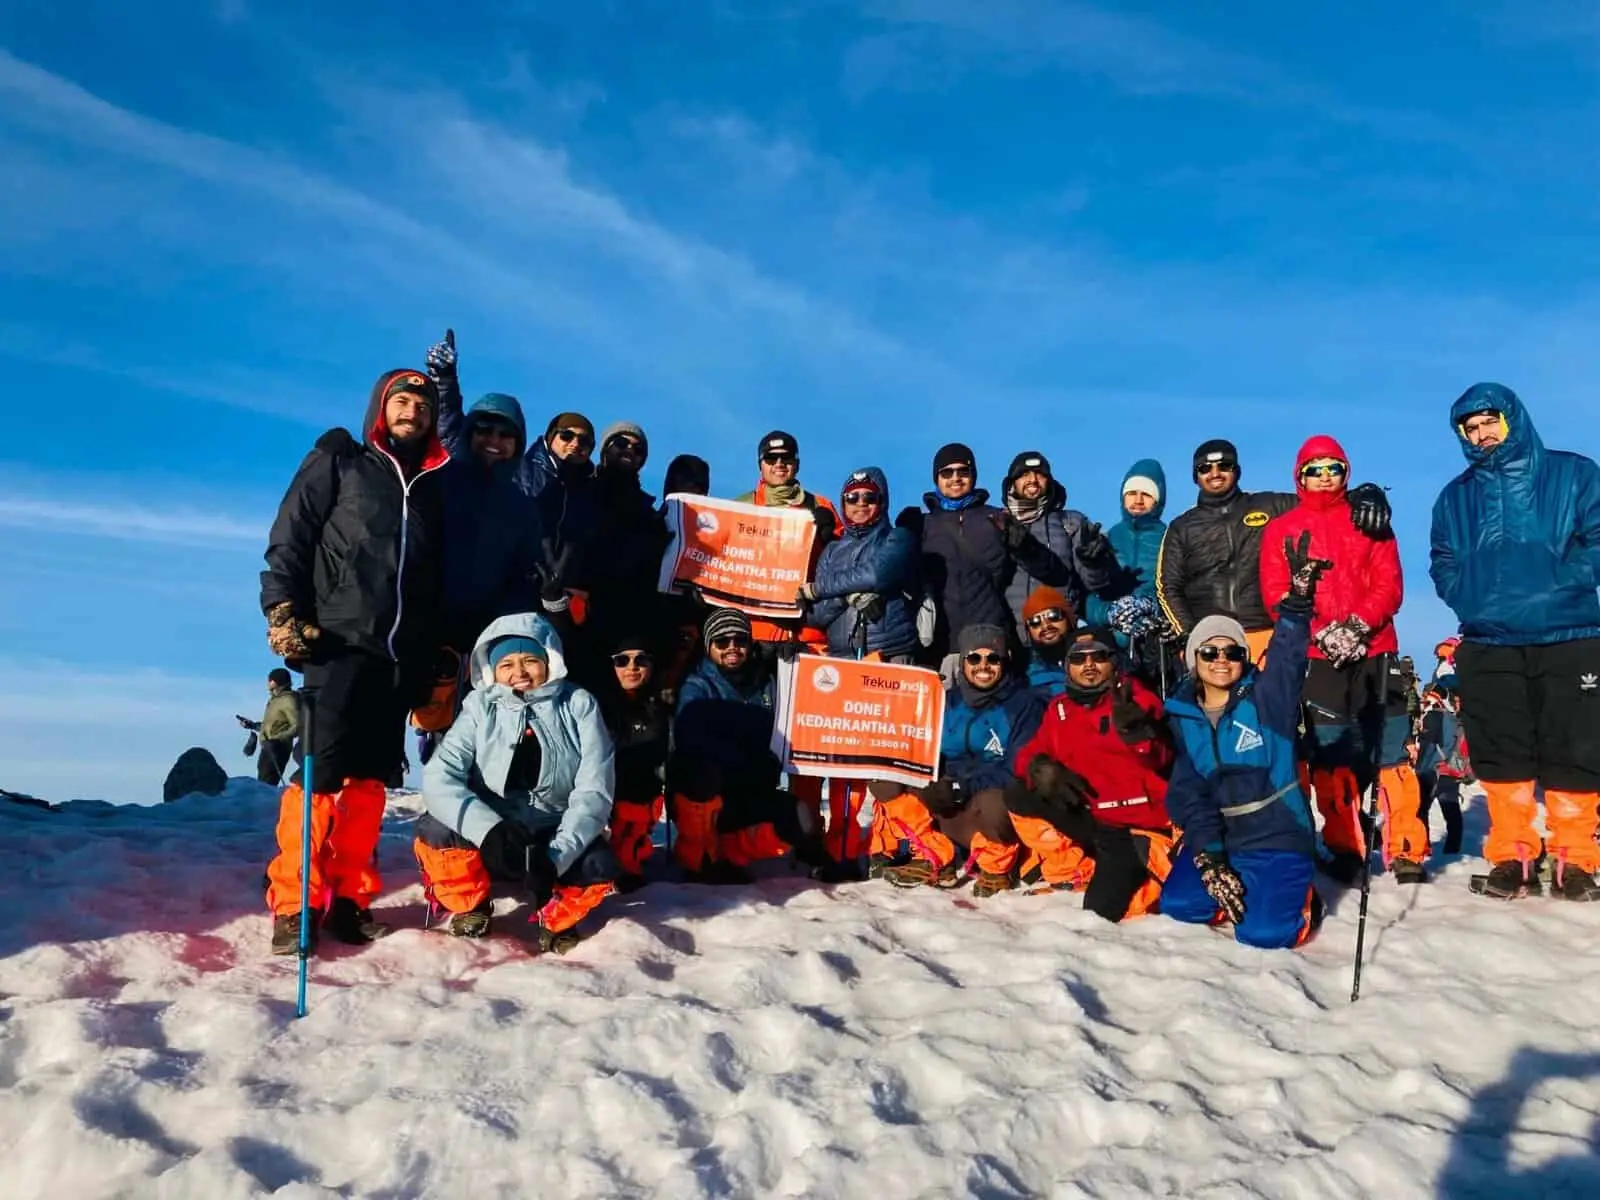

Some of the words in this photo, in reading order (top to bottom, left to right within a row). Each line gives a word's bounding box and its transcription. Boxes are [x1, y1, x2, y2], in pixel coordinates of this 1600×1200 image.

[685, 547, 766, 579] KEDARKANTHA
[771, 567, 800, 581] TREK
[844, 700, 881, 716] DONE
[797, 713, 896, 735] KEDARKANTHA
